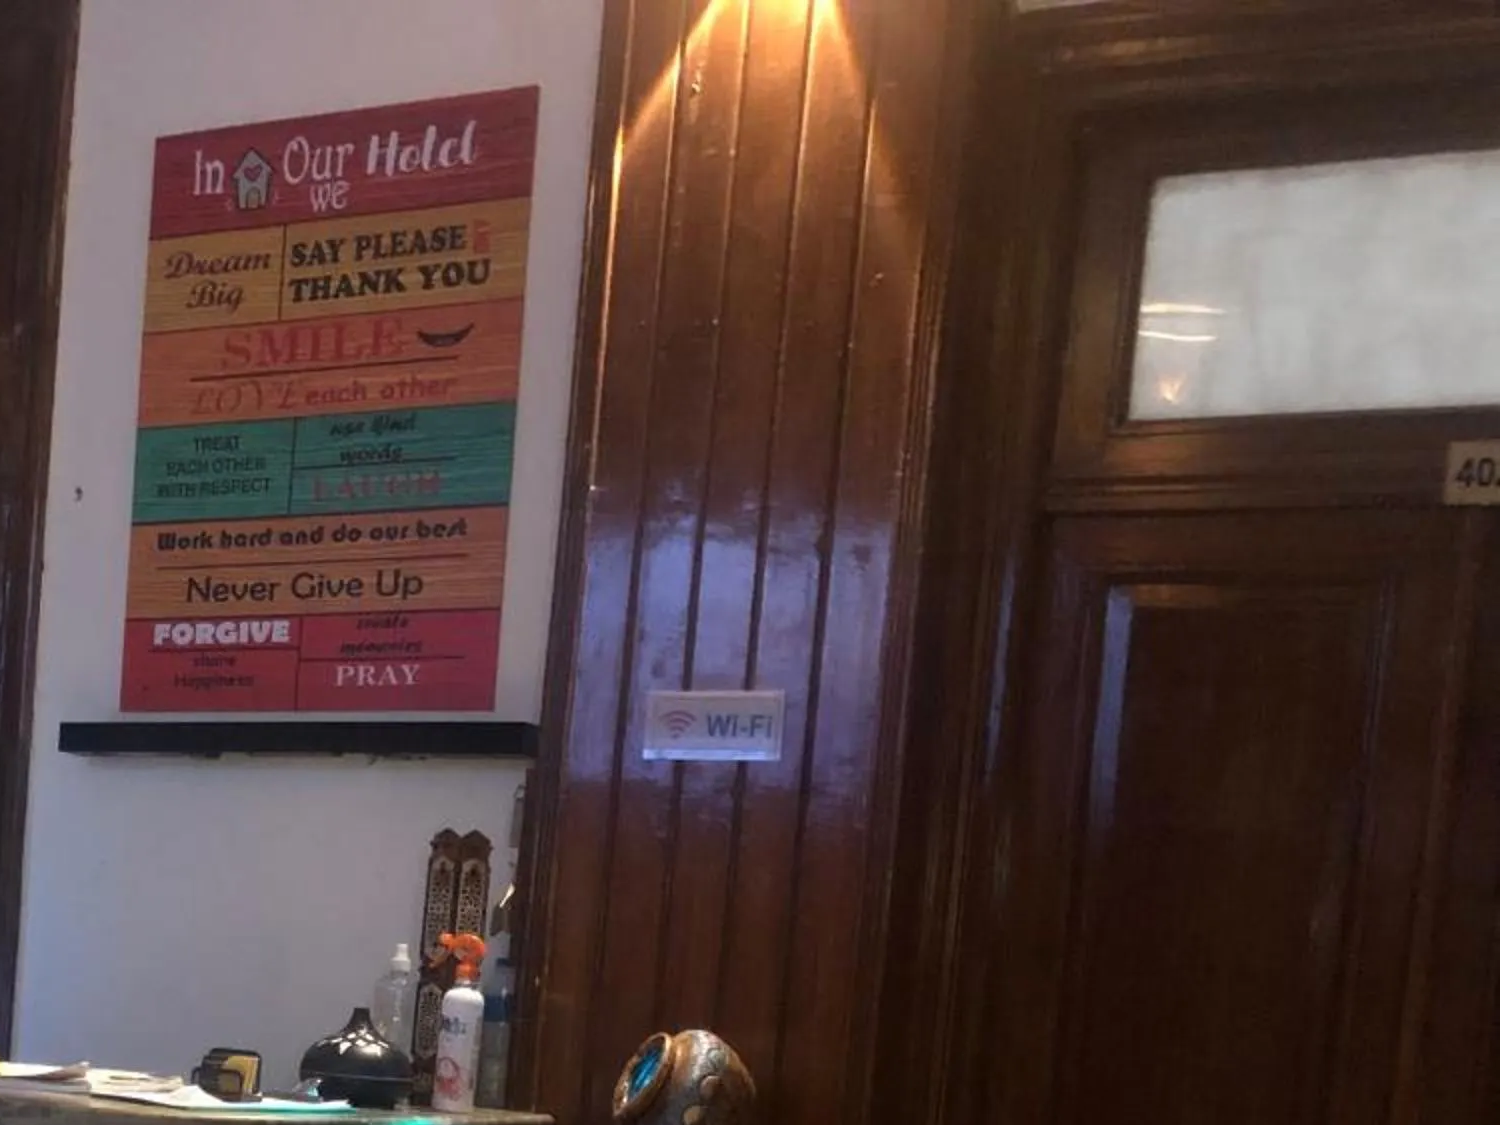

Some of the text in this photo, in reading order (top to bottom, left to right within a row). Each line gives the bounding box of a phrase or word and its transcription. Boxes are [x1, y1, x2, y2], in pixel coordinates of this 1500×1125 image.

[192, 150, 225, 197] In
[283, 135, 355, 186] Our
[310, 177, 351, 212] we
[289, 239, 346, 268] SAY
[354, 224, 467, 262] PLEASE
[164, 250, 272, 280] Dream
[288, 257, 492, 303] THANK YOU
[185, 278, 245, 316] Big
[221, 316, 407, 368] SMILE
[305, 380, 368, 405] each
[380, 373, 459, 400] other
[193, 434, 240, 453] TREAT
[166, 456, 266, 477] EACH OTHER
[1455, 457, 1500, 489] 40
[199, 476, 270, 496] RESPECT
[156, 517, 468, 552] Work hard and do our best
[185, 568, 425, 604] Never Give Up
[152, 619, 293, 647] FORGIVE
[334, 662, 422, 688] PRAY
